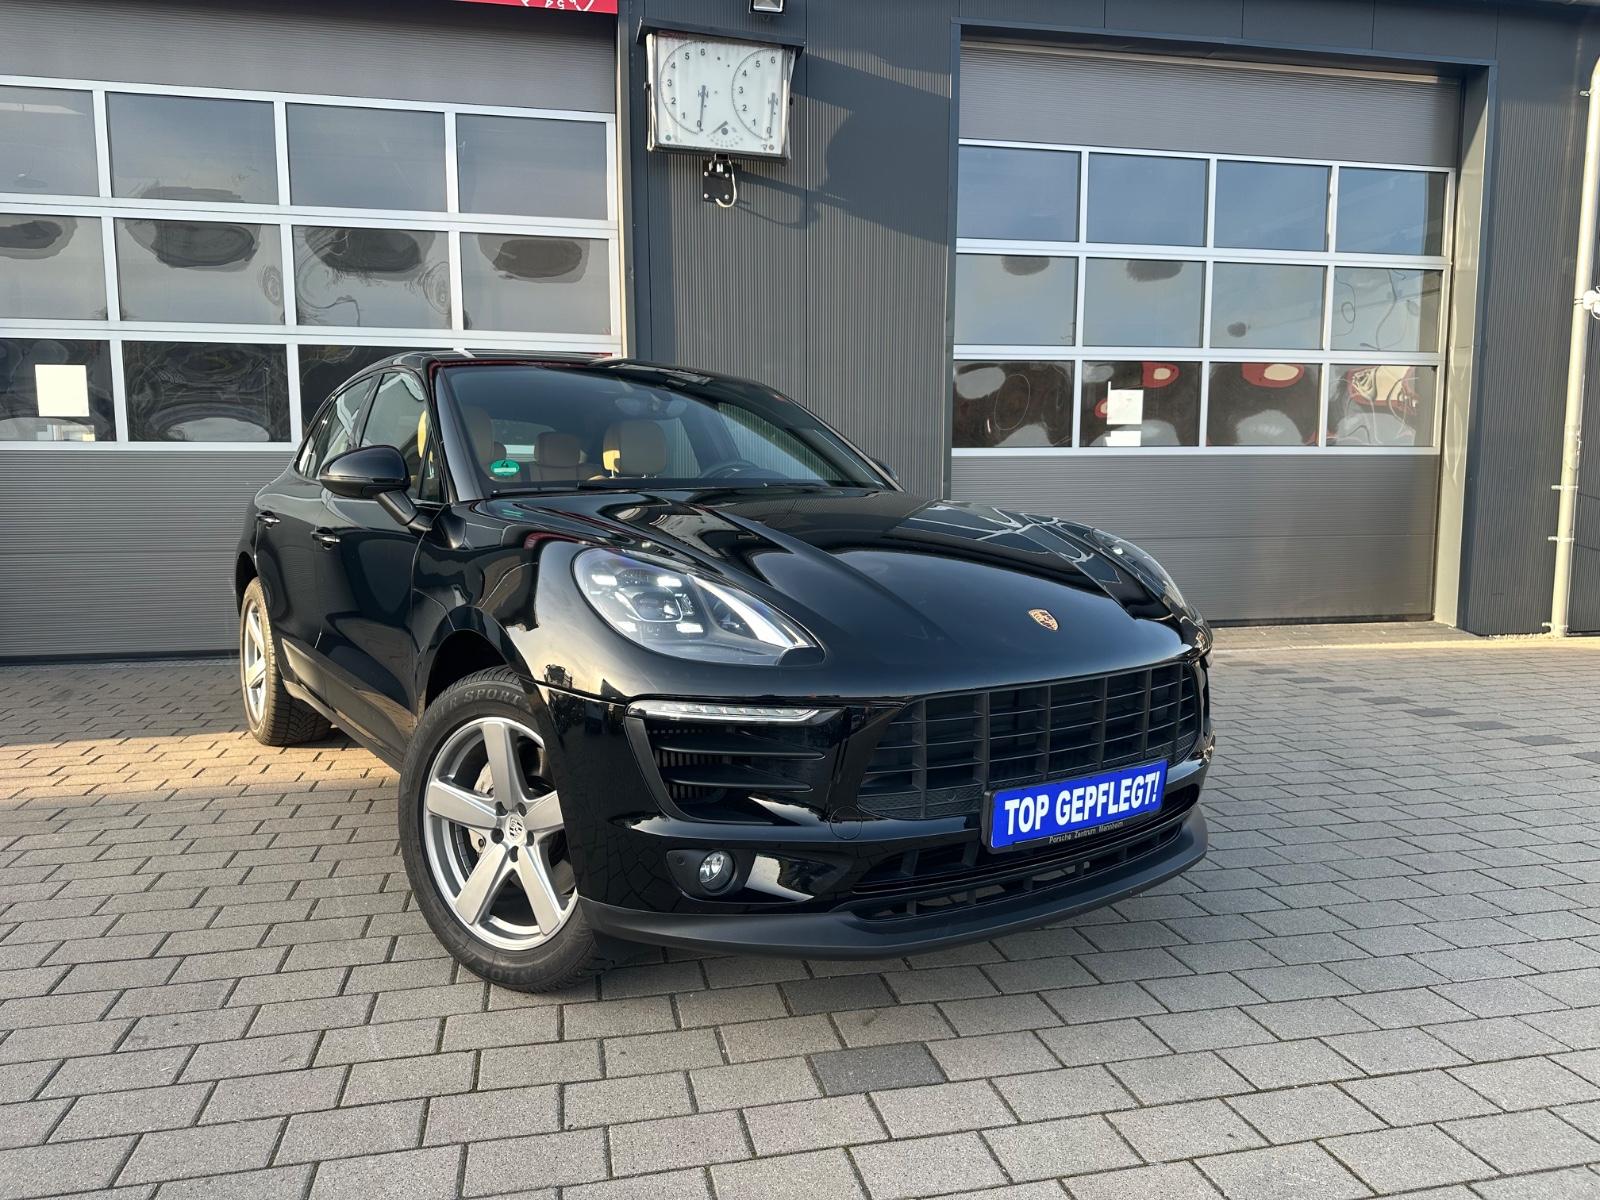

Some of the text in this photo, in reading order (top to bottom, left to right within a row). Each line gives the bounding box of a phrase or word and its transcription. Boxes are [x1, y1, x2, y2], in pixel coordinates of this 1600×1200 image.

[684, 52, 690, 60] 5
[700, 48, 706, 56] 6
[755, 60, 761, 68] 5
[770, 56, 776, 64] 6
[742, 69, 747, 77] 4
[667, 79, 673, 87] 3
[738, 86, 744, 94] 3
[671, 97, 677, 105] 2
[742, 104, 748, 112] 2
[463, 688, 522, 705] SPORT
[1005, 771, 1160, 835] TOP GEPFLEGT!
[1048, 821, 1124, 844] Porsche Zentrum Mannheim
